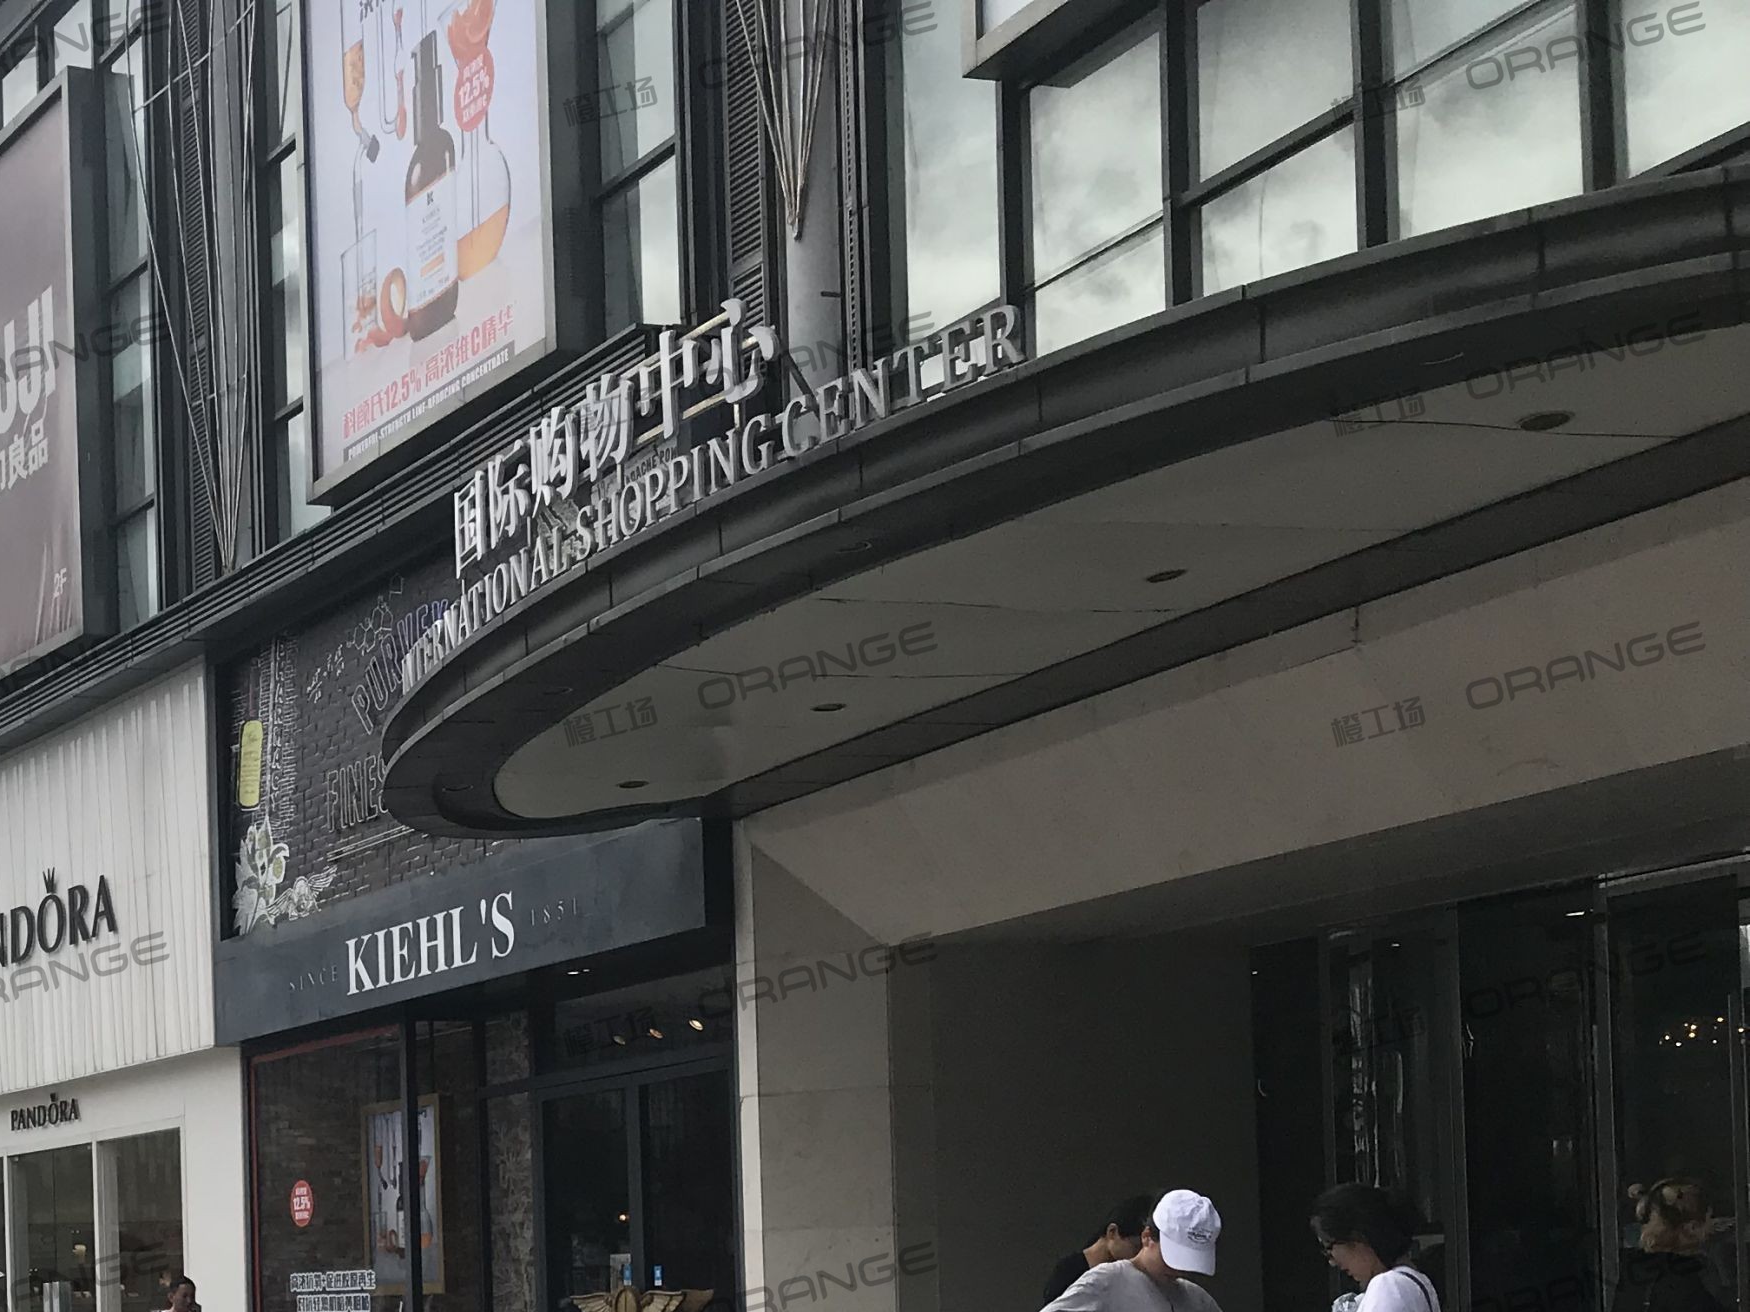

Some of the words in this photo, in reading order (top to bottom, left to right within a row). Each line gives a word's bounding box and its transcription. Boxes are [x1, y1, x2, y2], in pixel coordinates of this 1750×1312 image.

[453, 297, 780, 580] 国际购物中心
[575, 414, 775, 561] SHOPPING
[780, 304, 1028, 458] CENTER
[345, 890, 516, 997] KIEHL'S
[529, 896, 579, 928] 1851
[9, 1094, 81, 1132] PANDORA
